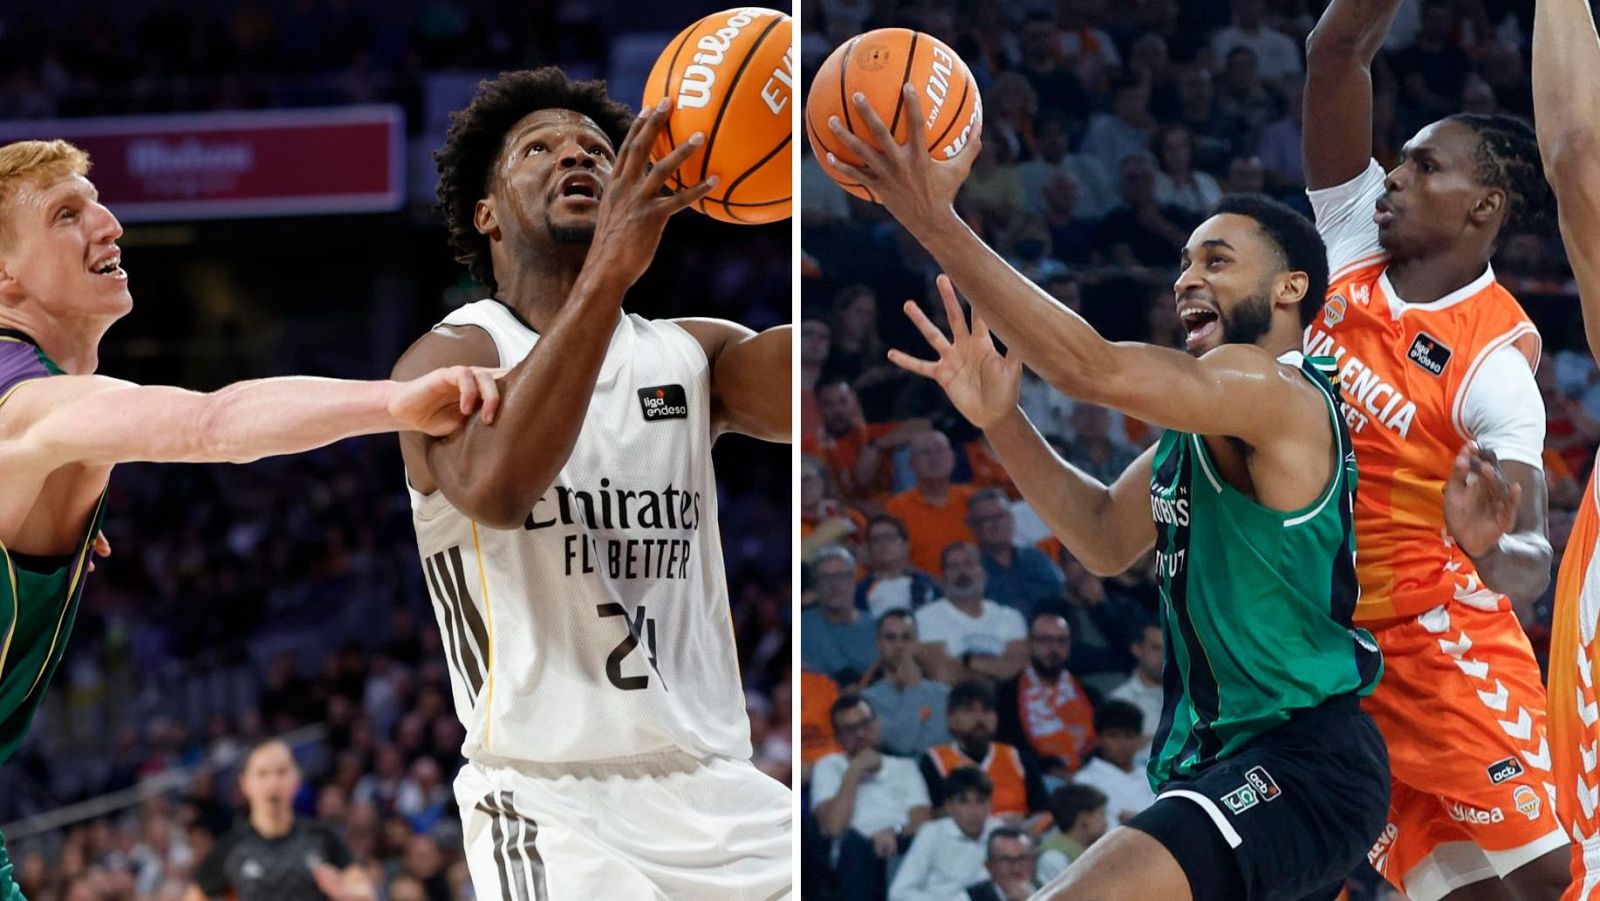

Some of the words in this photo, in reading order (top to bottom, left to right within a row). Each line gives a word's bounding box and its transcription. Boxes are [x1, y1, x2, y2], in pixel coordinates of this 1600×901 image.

[761, 47, 792, 115] EV
[926, 47, 952, 107] EVO
[643, 397, 664, 408] liga
[647, 405, 686, 417] endesa
[1340, 402, 1368, 434] KET
[565, 534, 602, 576] FL
[608, 539, 691, 580] BETTER
[1250, 772, 1268, 794] acb
